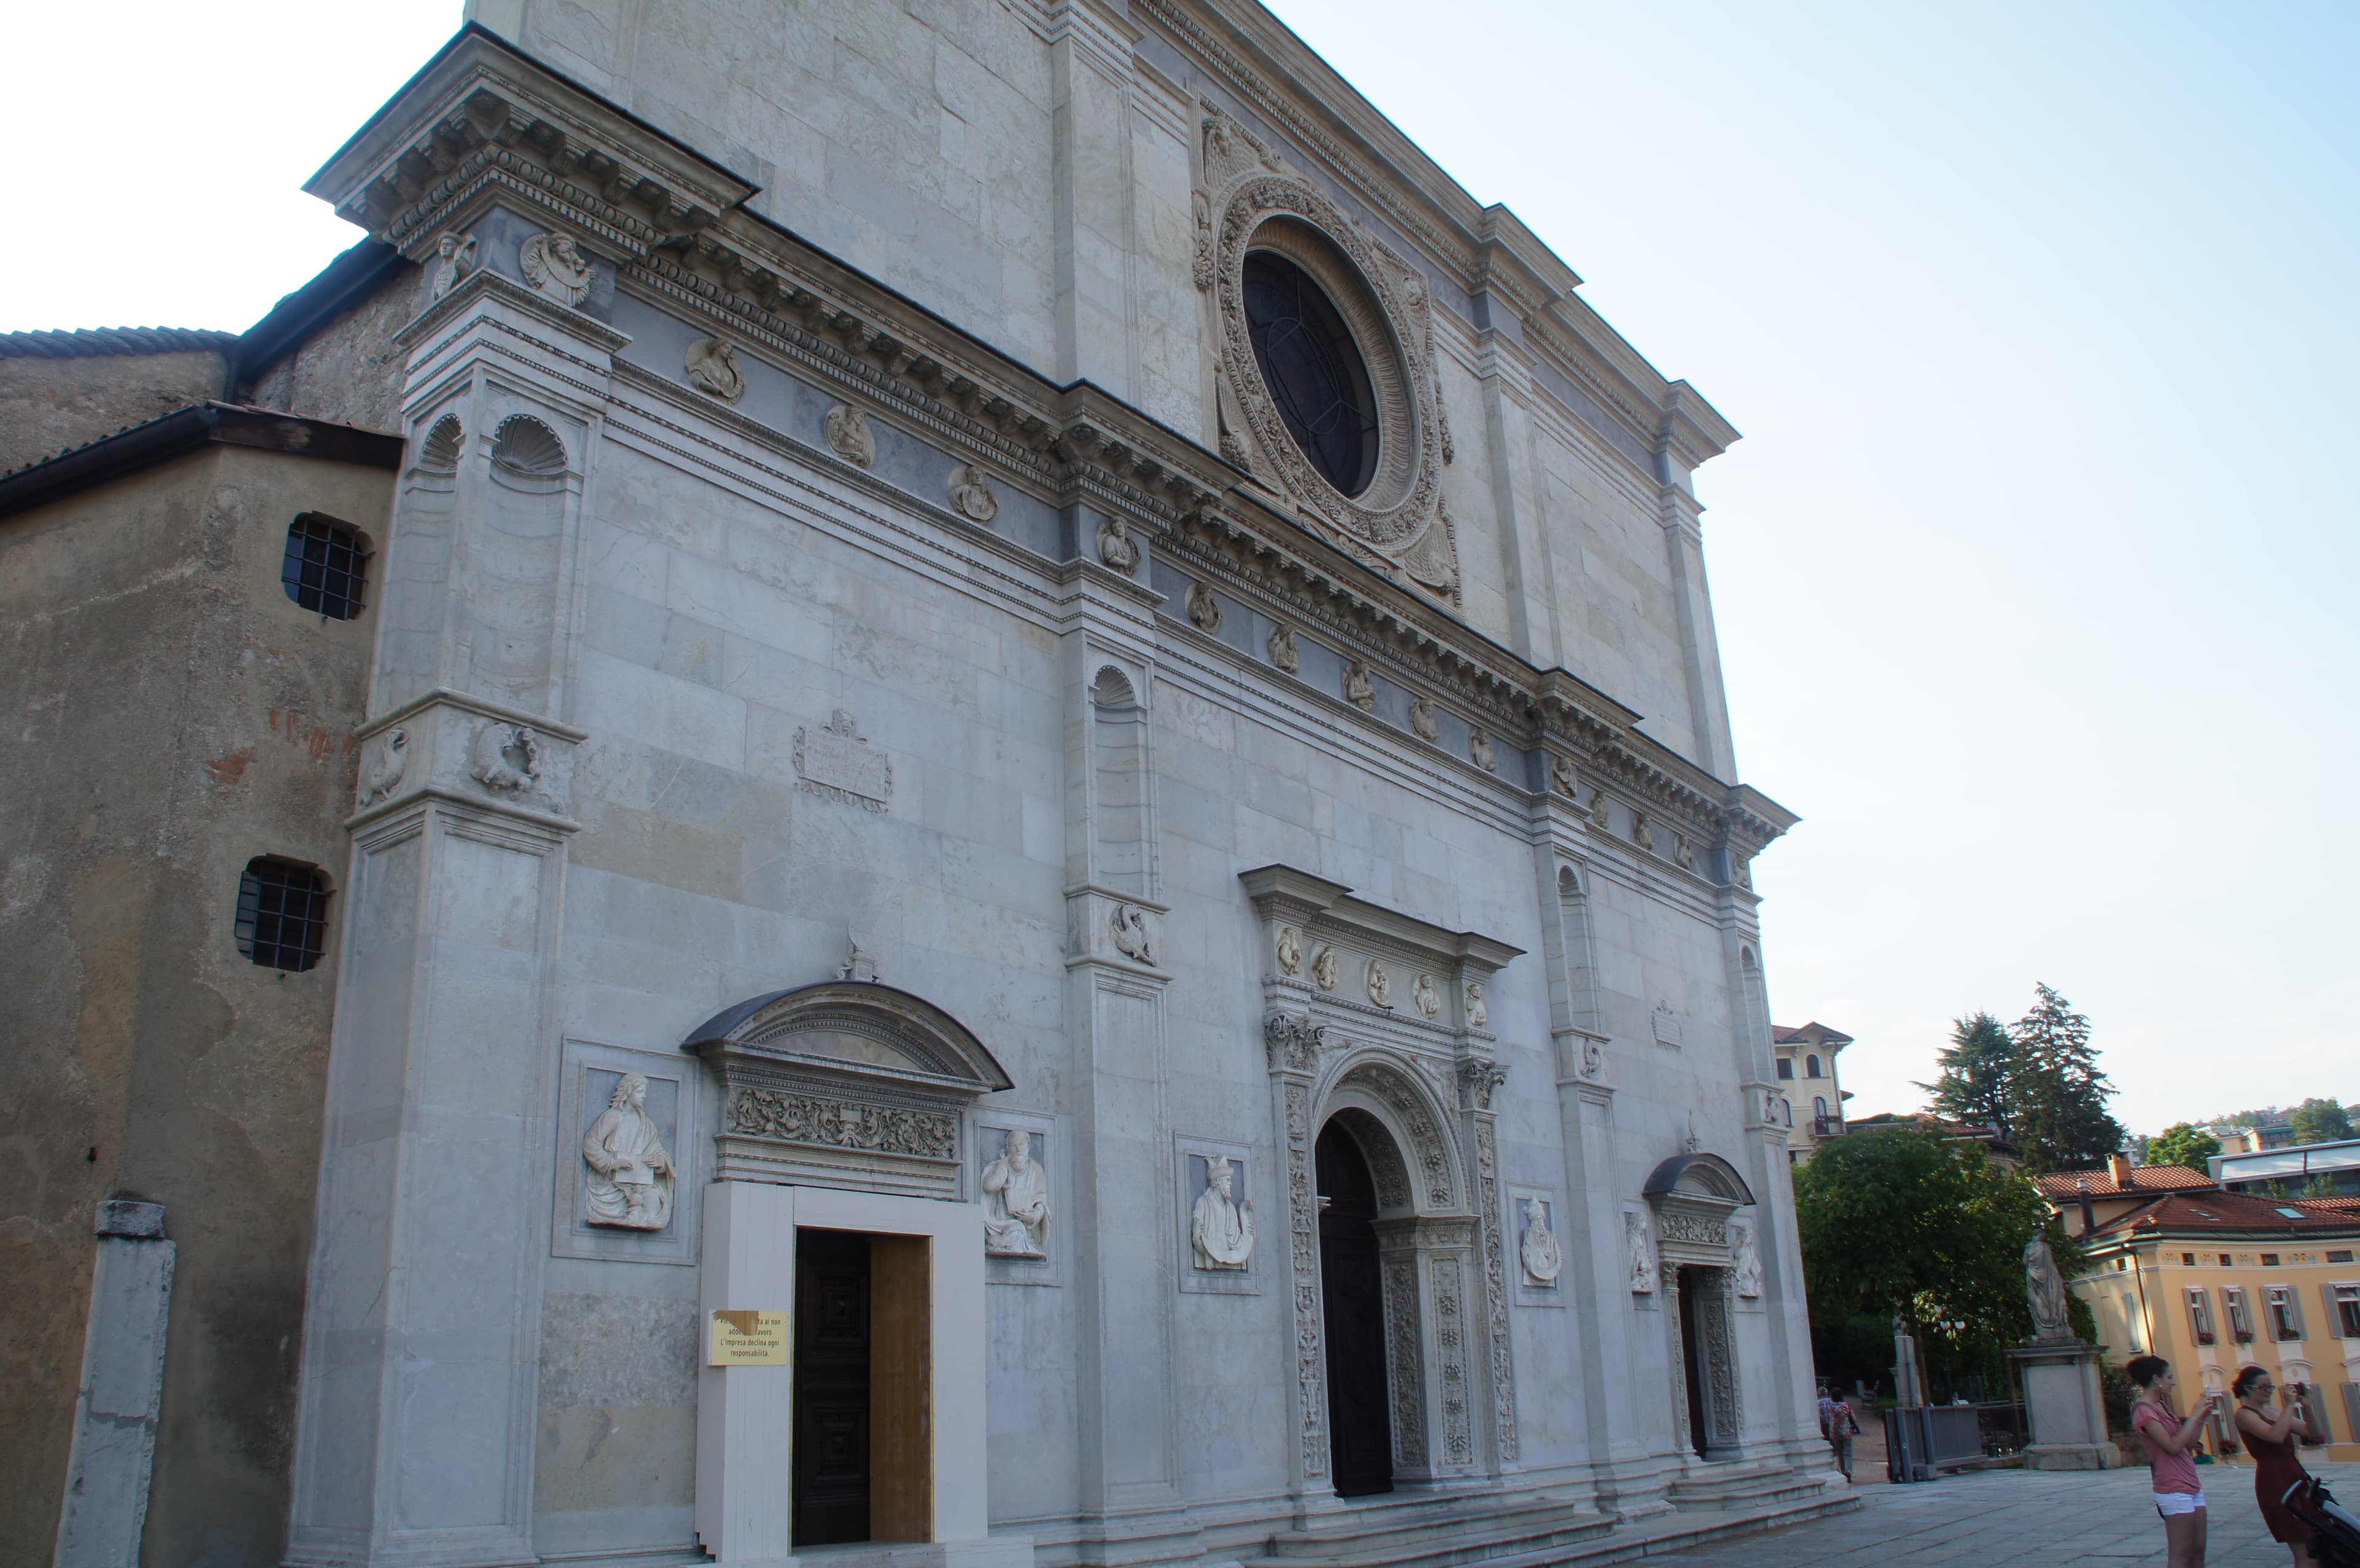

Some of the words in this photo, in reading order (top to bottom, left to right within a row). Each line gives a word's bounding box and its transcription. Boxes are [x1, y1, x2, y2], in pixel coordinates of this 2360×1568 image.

[721, 1338, 746, 1347] L'impresa
[768, 1338, 780, 1347] ogni
[731, 1349, 769, 1358] responsabilità.
